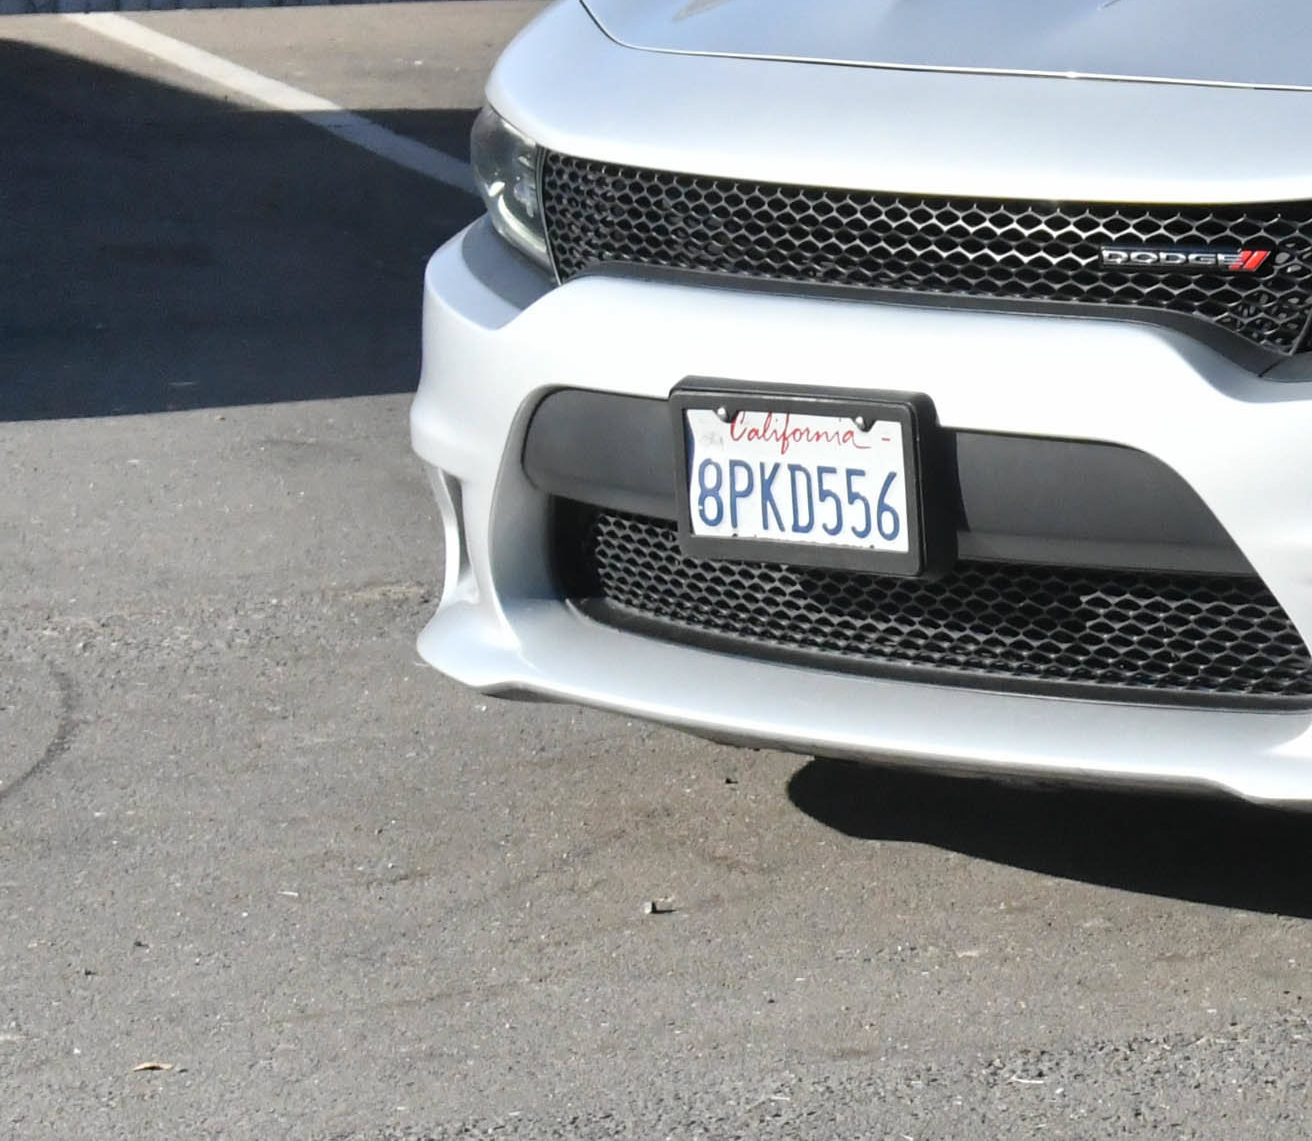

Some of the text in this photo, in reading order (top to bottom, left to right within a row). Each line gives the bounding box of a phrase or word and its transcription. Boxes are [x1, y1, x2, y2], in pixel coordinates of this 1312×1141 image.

[1102, 249, 1244, 266] DODGE
[730, 410, 872, 455] California
[698, 458, 900, 541] 8PKD556
